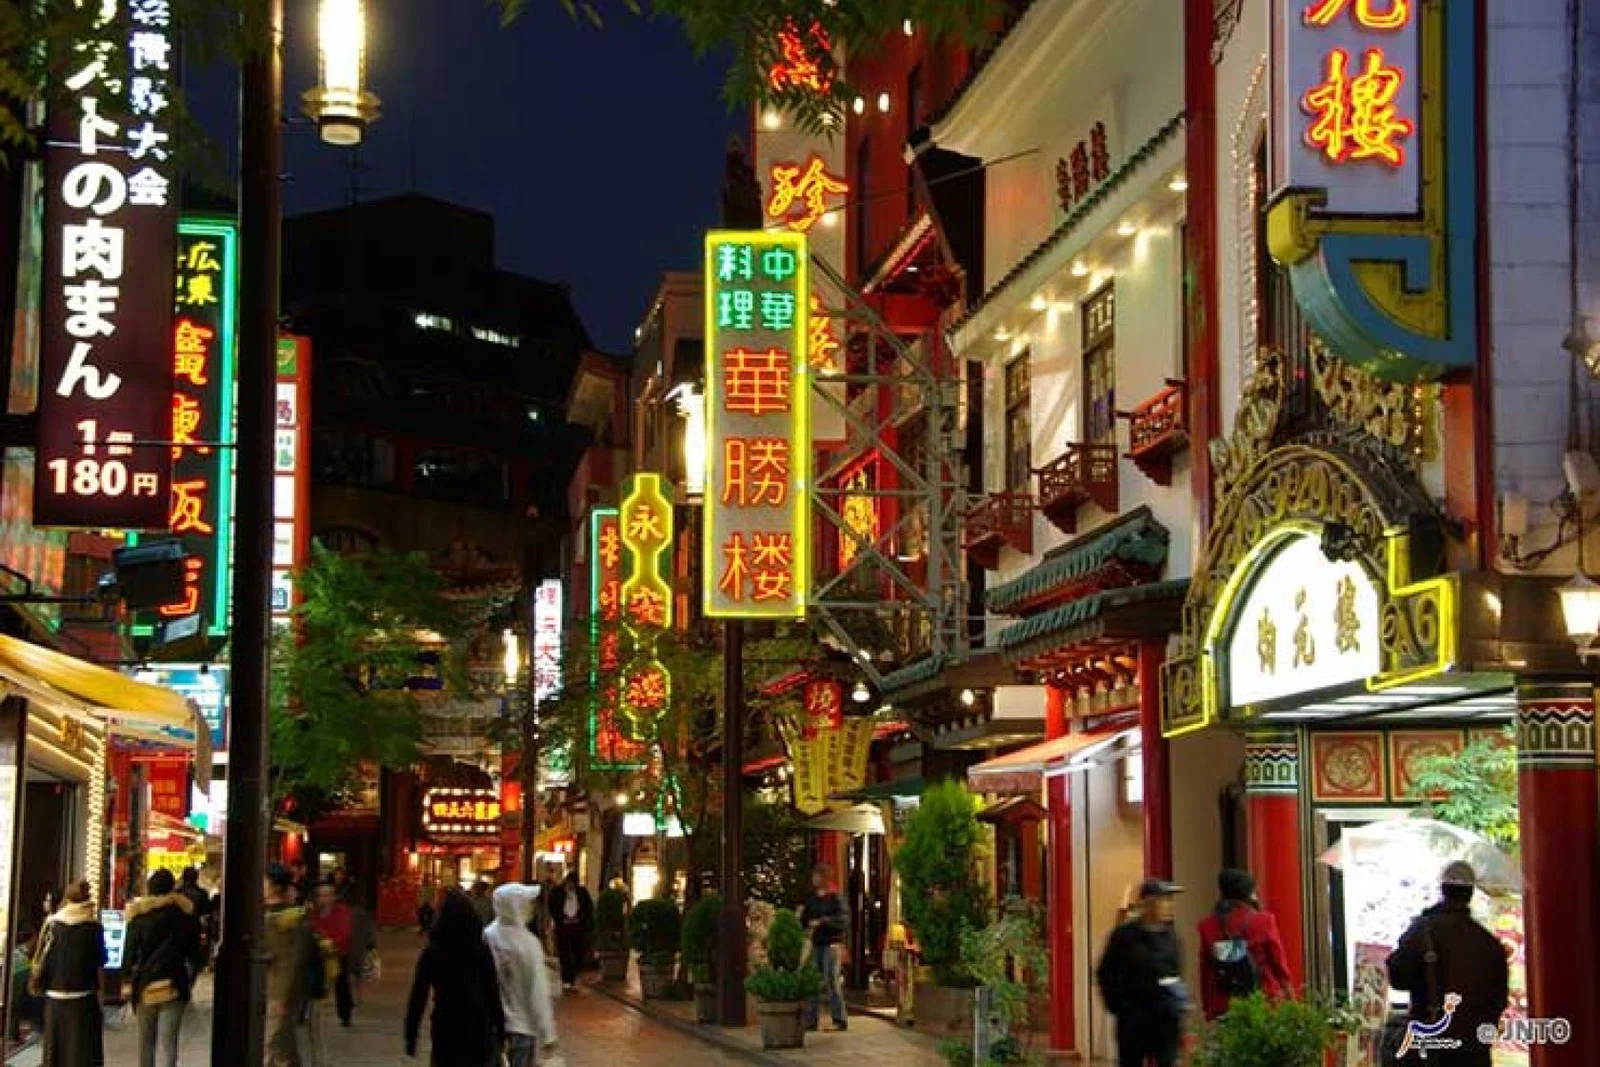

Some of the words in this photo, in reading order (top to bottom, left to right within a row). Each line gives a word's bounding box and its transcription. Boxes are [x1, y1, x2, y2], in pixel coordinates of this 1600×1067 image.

[718, 244, 755, 330] 料理
[761, 246, 796, 332] 中華
[47, 457, 159, 497] 180円
[718, 348, 792, 601] 華勝楼
